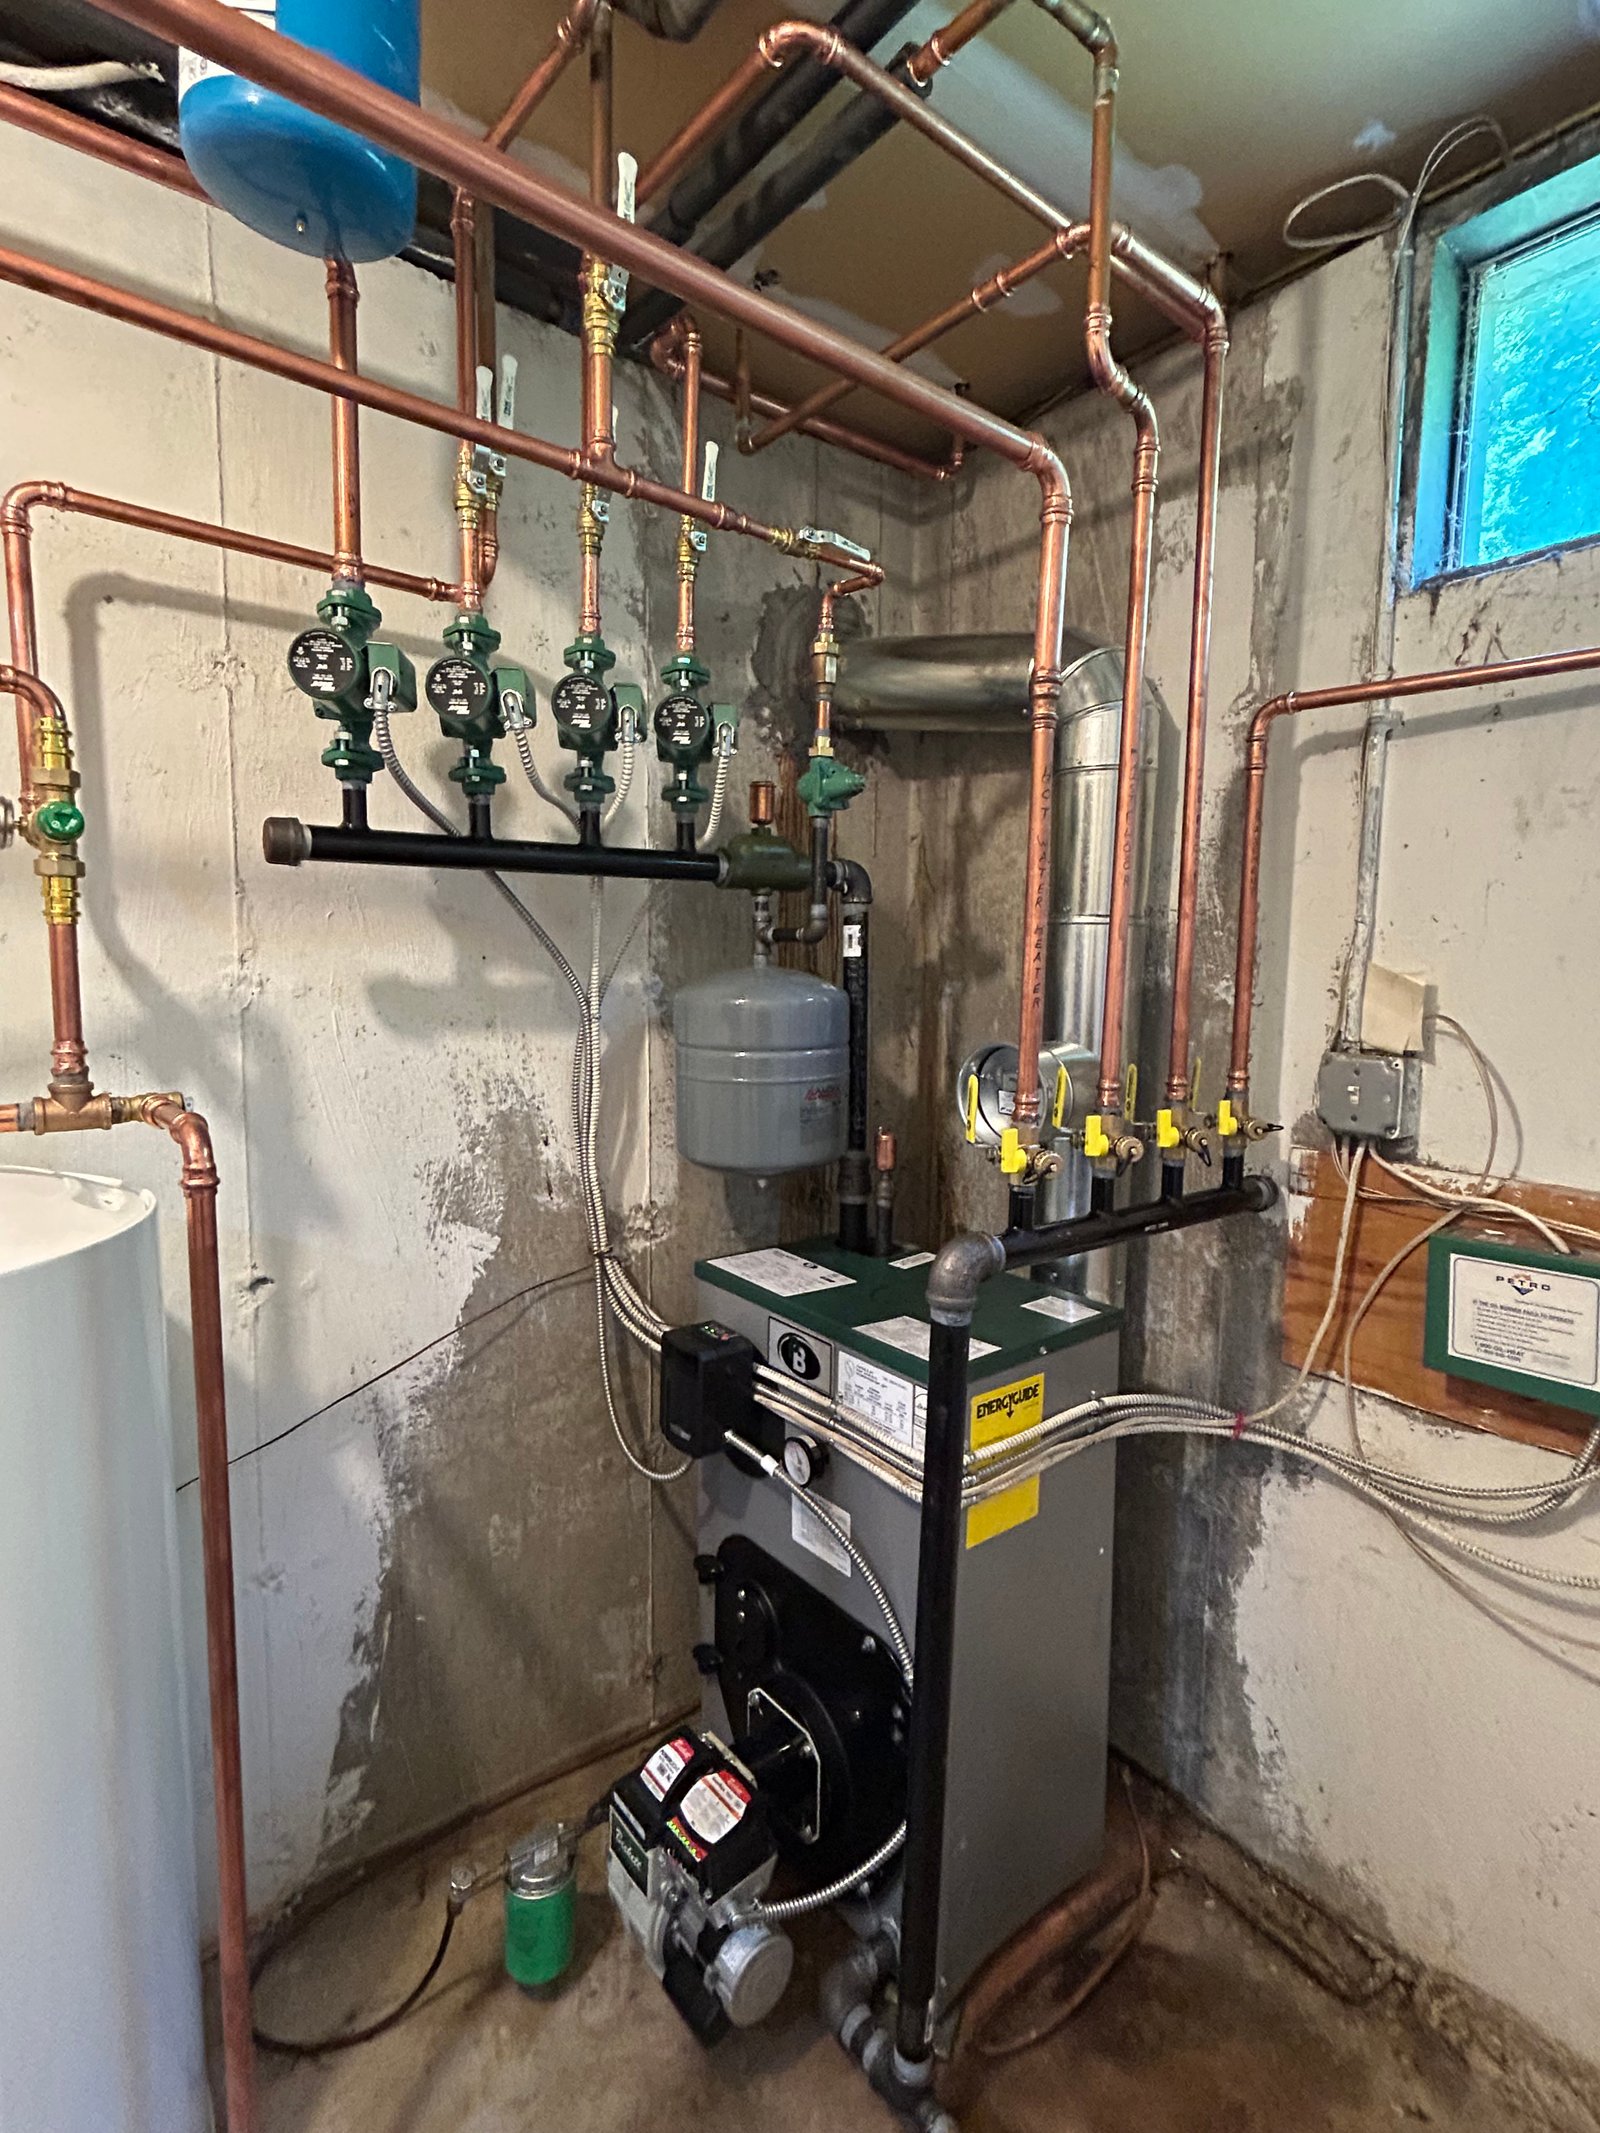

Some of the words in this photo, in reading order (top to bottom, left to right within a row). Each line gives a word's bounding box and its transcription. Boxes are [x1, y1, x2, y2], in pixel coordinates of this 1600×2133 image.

[1041, 766, 1051, 818] HOT
[1035, 834, 1048, 908] WATER
[1032, 924, 1044, 1009] HEATER
[1496, 1276, 1551, 1290] PETRO
